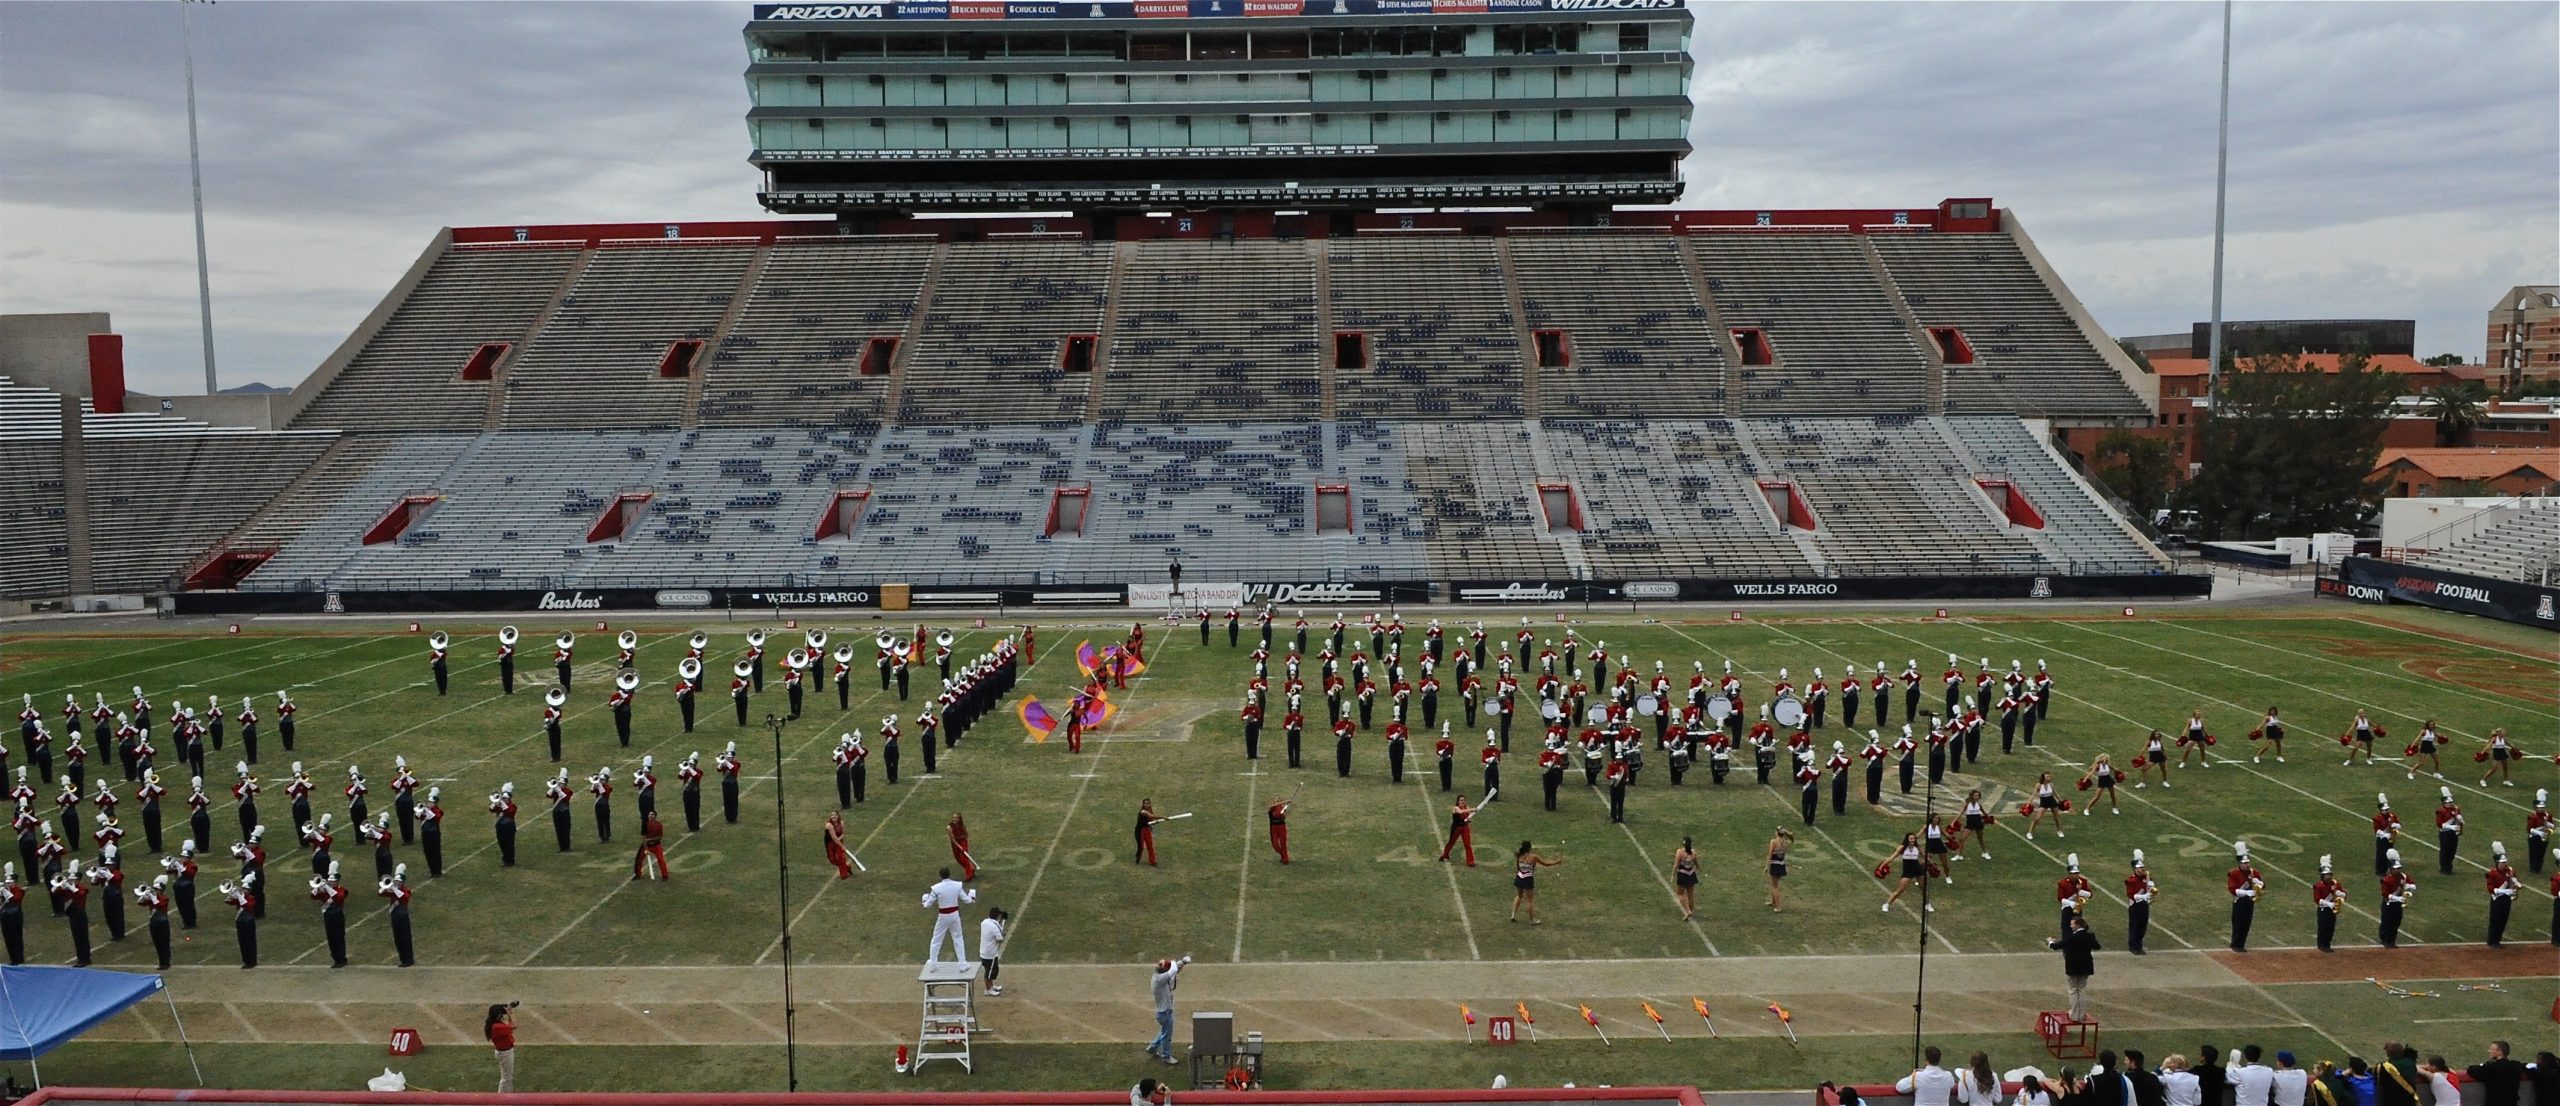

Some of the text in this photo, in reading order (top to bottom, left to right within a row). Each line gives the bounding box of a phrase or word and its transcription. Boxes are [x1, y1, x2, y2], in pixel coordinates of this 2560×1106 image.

[1551, 0, 1676, 10] WILDCATS
[767, 5, 882, 19] ARIZONA
[897, 6, 906, 14] 22
[906, 6, 919, 14] ART
[1401, 220, 1414, 229] 22
[1597, 218, 1610, 227] 23
[1757, 218, 1770, 226] 24
[1894, 216, 1907, 225] 25
[840, 226, 850, 235] 19
[1032, 224, 1046, 233] 20
[1180, 222, 1190, 231] 21
[516, 233, 526, 242] 17
[667, 230, 678, 238] 18
[162, 401, 172, 409] 16
[1734, 584, 1838, 595] WELLS FARGO
[2434, 582, 2491, 602] FOOTBALL
[676, 593, 707, 601] CASINOS
[765, 592, 869, 604] WELLS FARGO
[1131, 590, 1166, 600] UNIVERSITY
[1206, 590, 1225, 600] BAND
[1226, 590, 1239, 599] DAY
[538, 592, 602, 610] Bashas'
[2155, 833, 2304, 857] 20
[980, 847, 1116, 872] 50
[1376, 844, 1514, 867] 40
[1492, 1021, 1511, 1040] 40
[392, 1032, 410, 1052] 40
